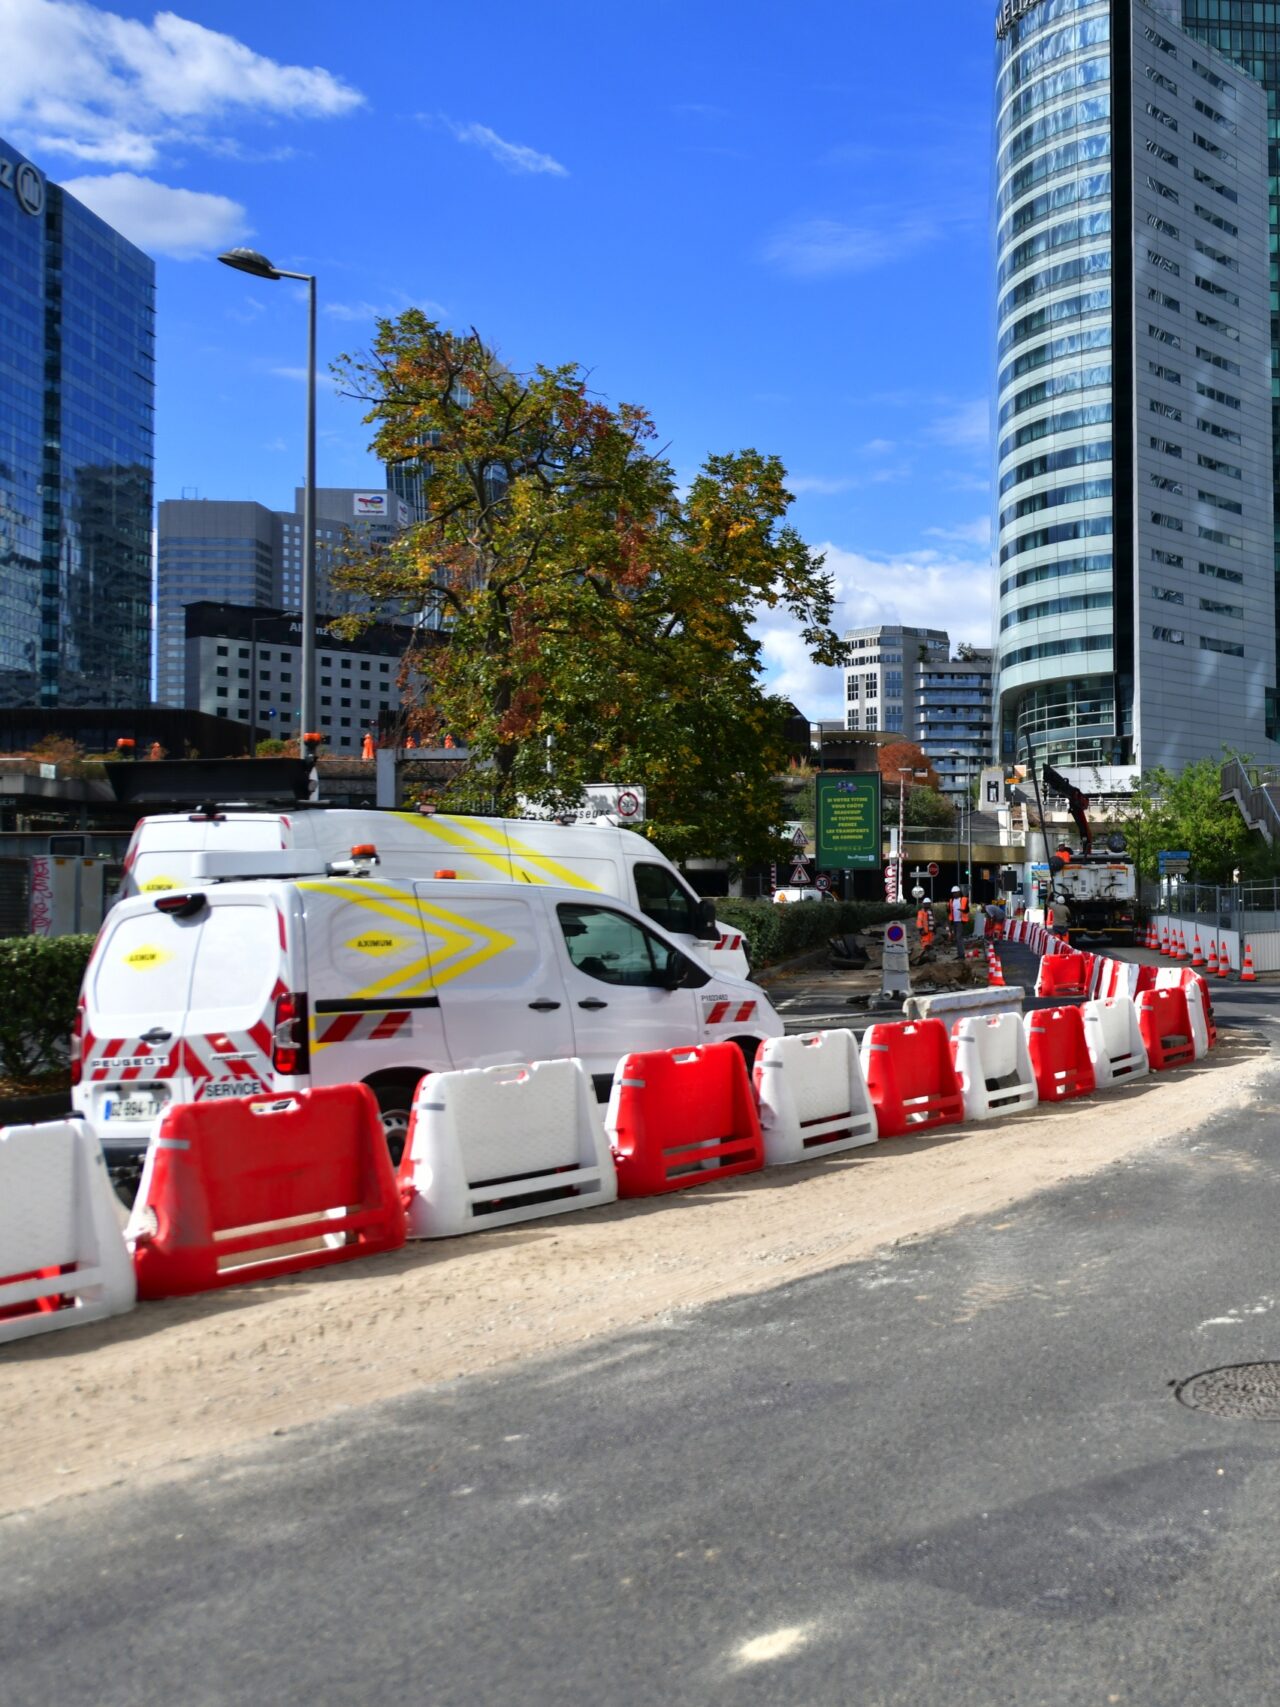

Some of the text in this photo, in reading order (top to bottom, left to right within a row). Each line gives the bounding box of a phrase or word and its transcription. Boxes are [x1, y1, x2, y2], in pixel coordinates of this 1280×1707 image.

[289, 621, 329, 636] Alnz
[818, 879, 828, 887] 30
[92, 1057, 166, 1067] PEUGEOT
[206, 1082, 260, 1097] SERVICE
